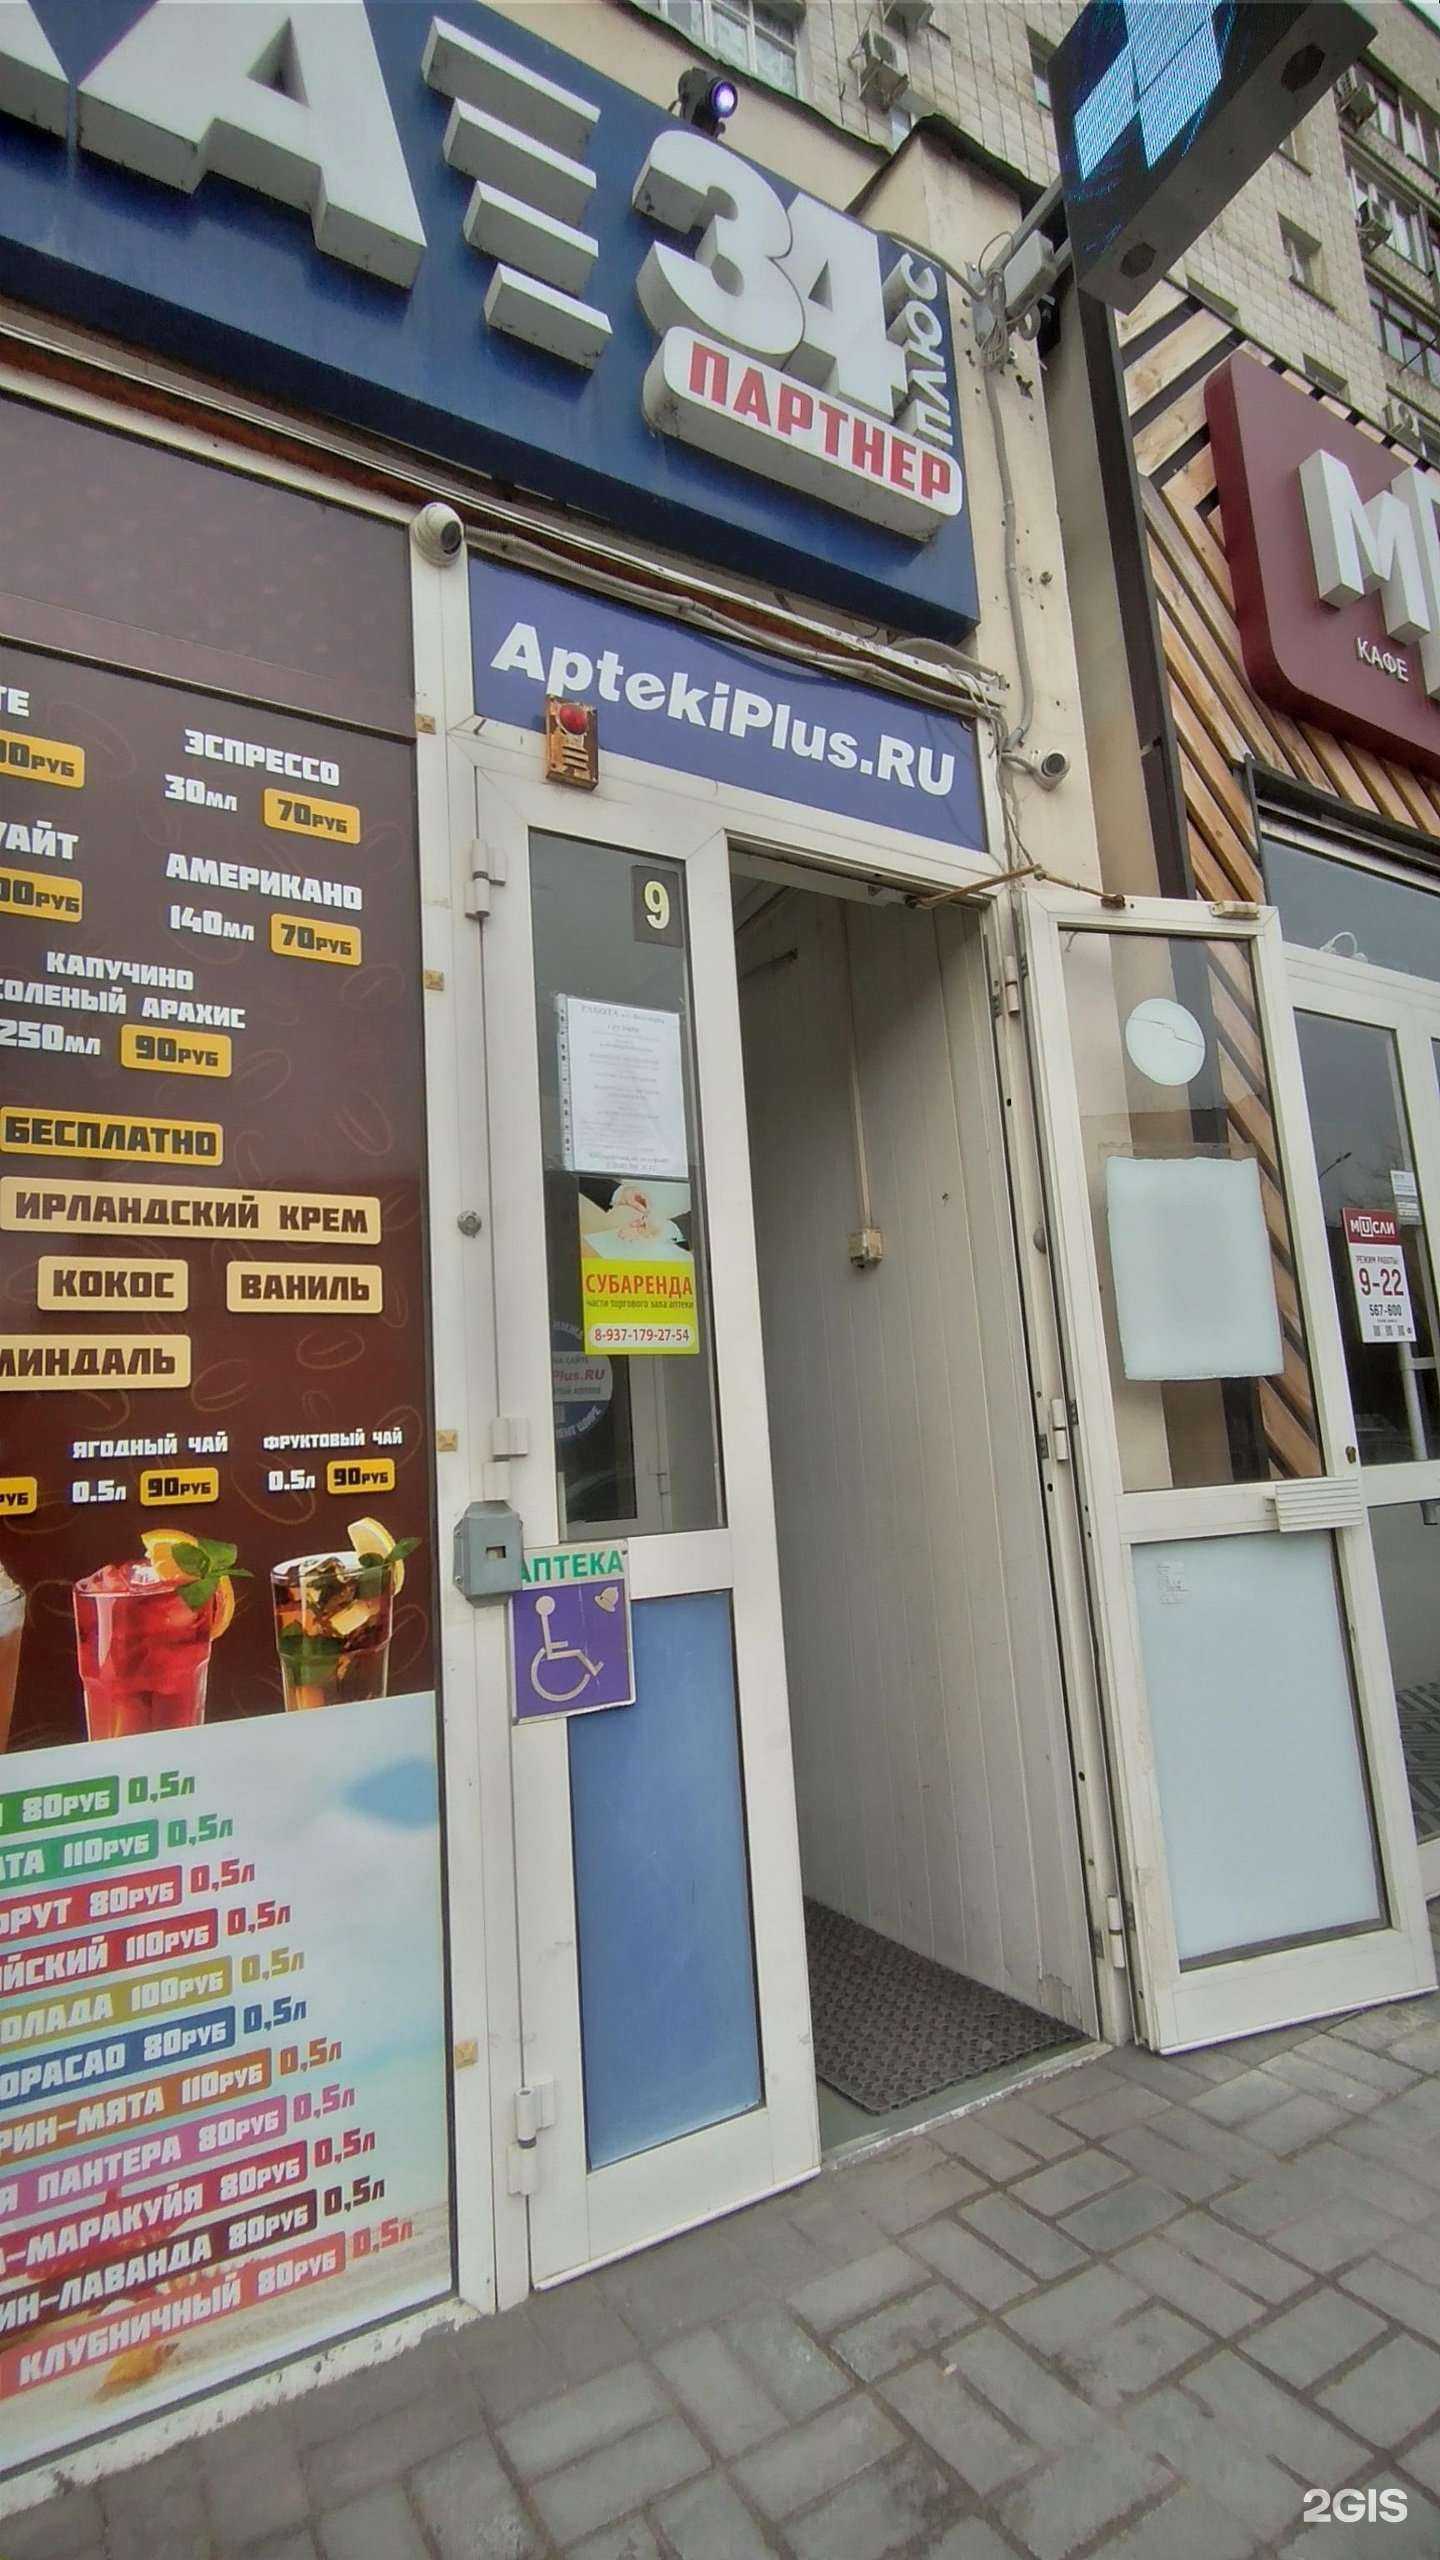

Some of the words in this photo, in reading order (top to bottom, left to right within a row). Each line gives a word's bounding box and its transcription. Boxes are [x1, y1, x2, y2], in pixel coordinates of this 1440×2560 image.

[0, 0, 426, 250] А
[642, 130, 908, 416] 34
[898, 252, 954, 446] ПЛЮС
[688, 341, 952, 501] ПАРТНЕР
[1357, 637, 1409, 683] КАФЕ
[490, 622, 955, 796] AptekiPlus.RU
[184, 728, 340, 787] ЭСПРЕССО
[0, 820, 79, 861] АЙТ
[166, 852, 363, 911] АМЕРИКАНО
[643, 880, 671, 930] 9
[46, 950, 195, 992] КАПУЧИНО
[0, 978, 127, 1015] ОЛЕНЫЙ
[141, 996, 247, 1030] АРАХИС
[5, 1115, 218, 1158] БЕСПЛАТНО
[15, 1191, 260, 1230] ИРЛАНДСКИЙ
[279, 1203, 369, 1234] КРЕМ
[53, 1268, 176, 1299] КОКОС
[240, 1272, 371, 1302] ВАНИЛЬ
[585, 1273, 693, 1299] СУБАРЕНДА
[1358, 1267, 1405, 1297] 9-22
[594, 1327, 690, 1342] 8-937-179-27-54
[72, 1432, 178, 1459] ЯГОДНЫЙ
[188, 1429, 230, 1454] ЧАЙ
[263, 1428, 365, 1451] ФРУКТОВЫЙ
[372, 1426, 403, 1447] ЧАЙ
[0, 1848, 45, 1881] ТА
[0, 1935, 109, 1992] ЙСКИЙ
[38, 2136, 182, 2202] ПАНТЕРА
[0, 2183, 204, 2275] -МАРАКУЙЯ
[19, 2271, 242, 2386] КЛУБНИЧНЫЙ
